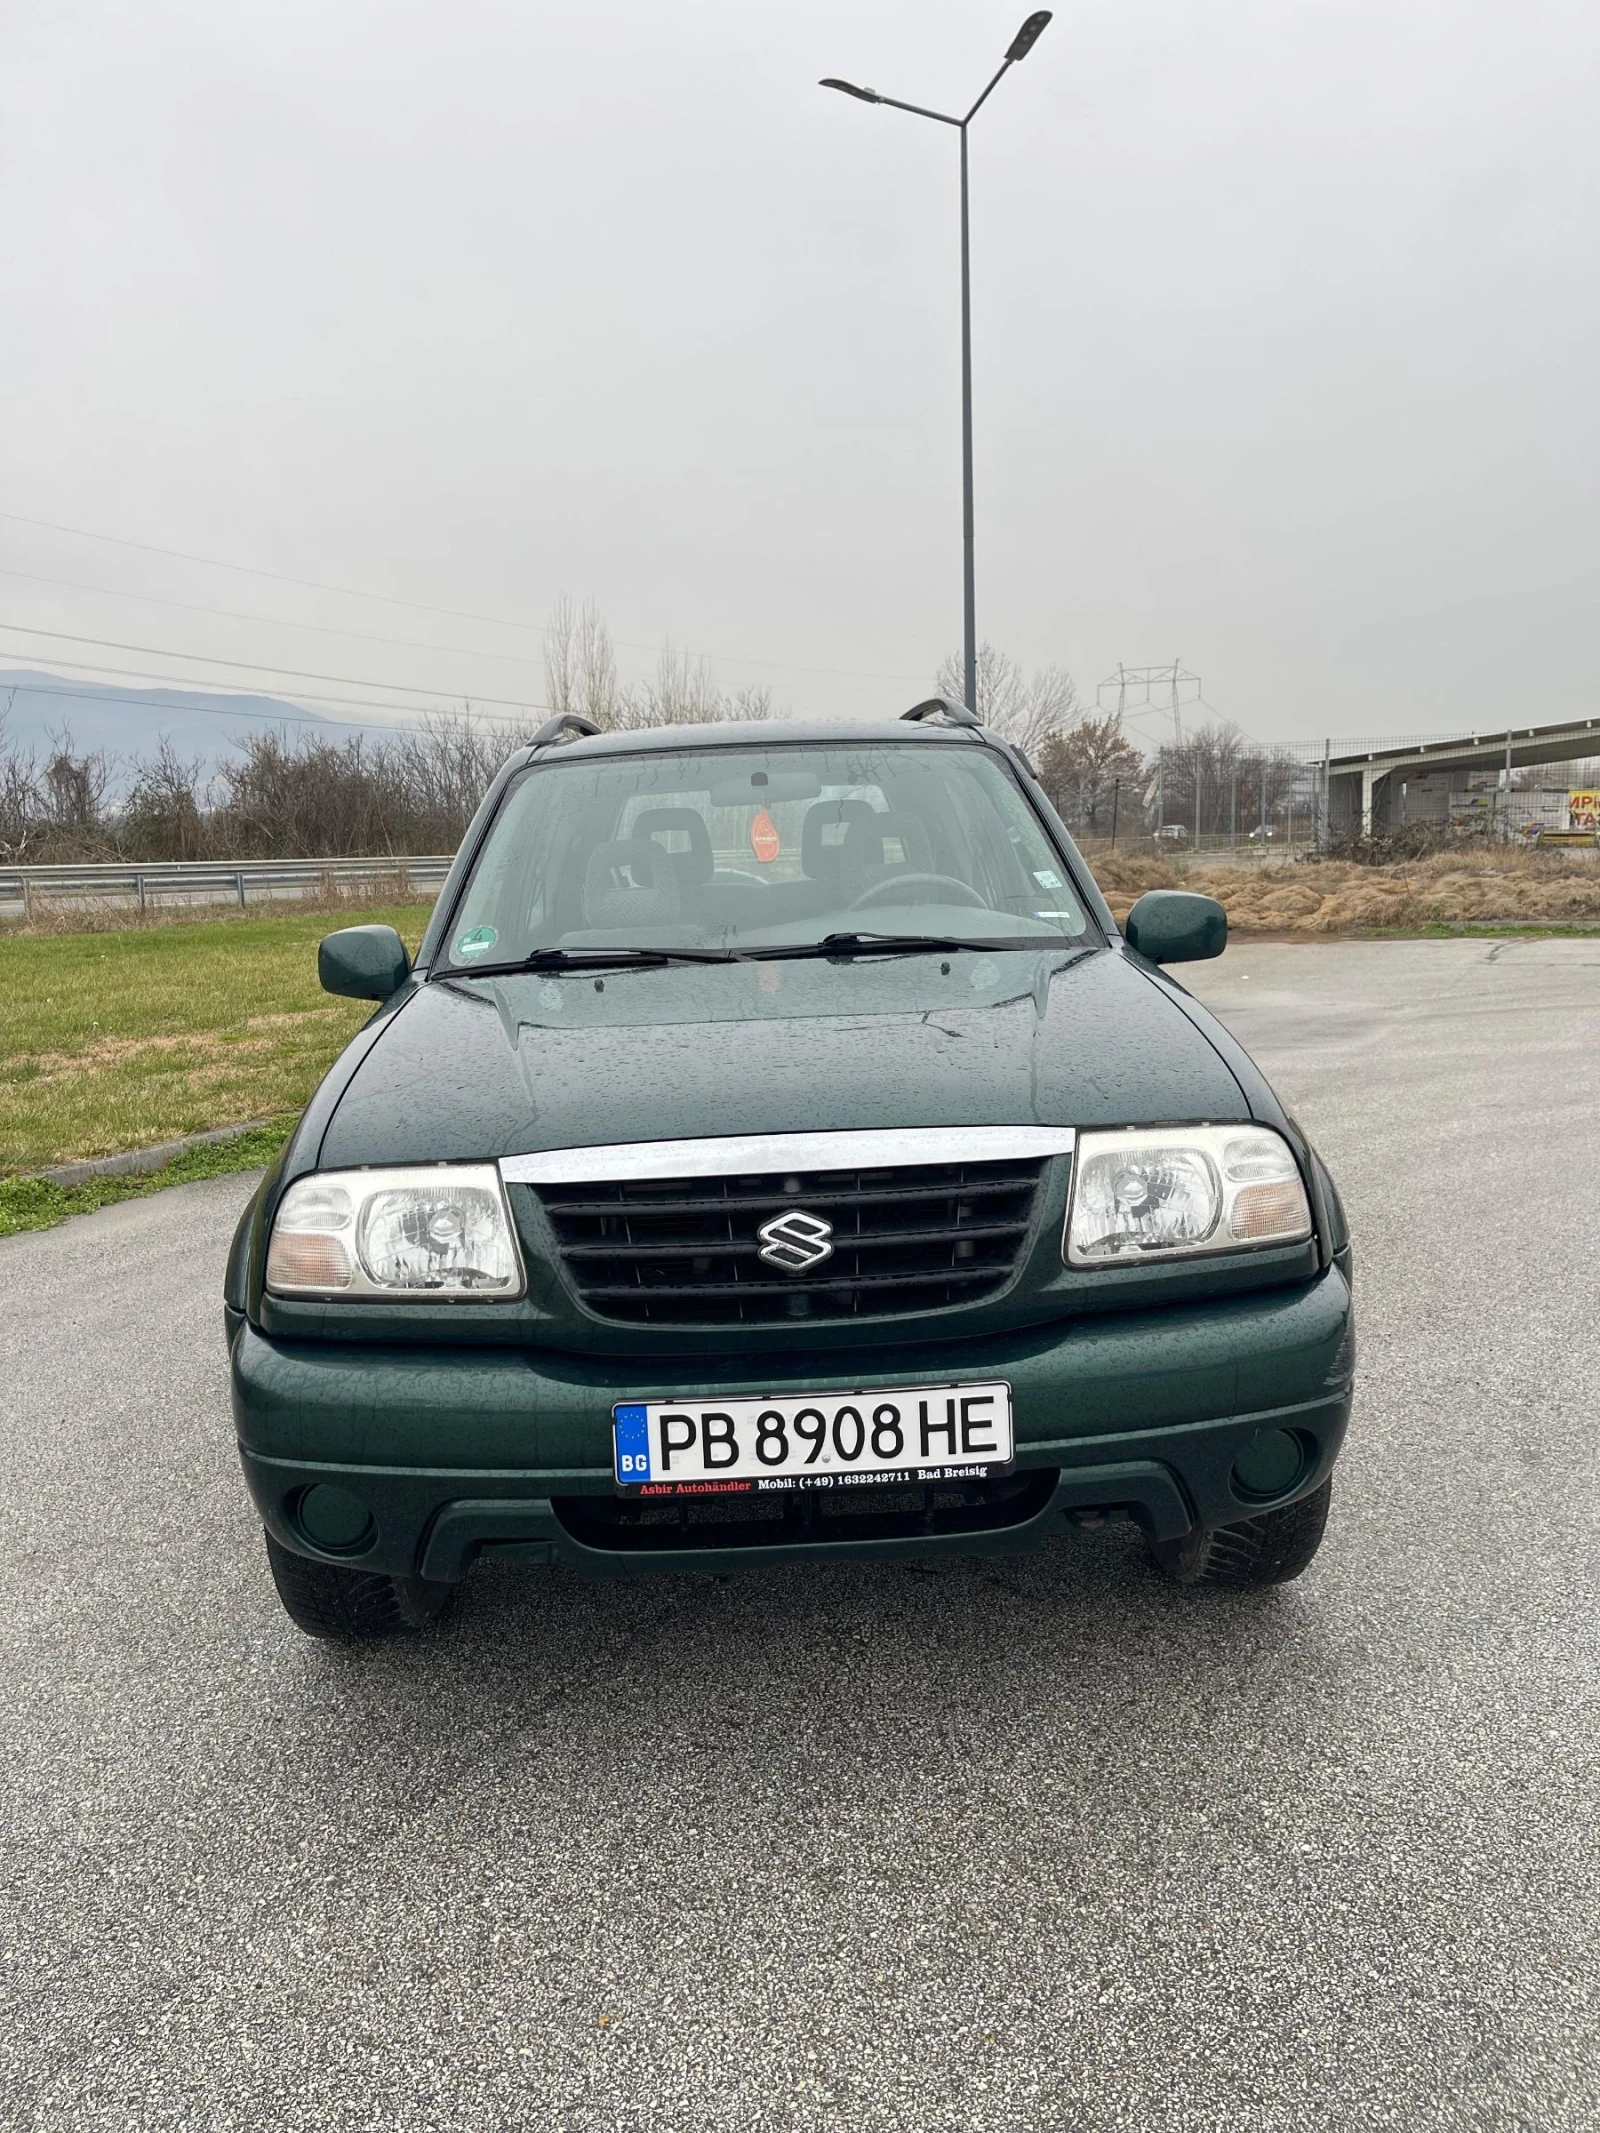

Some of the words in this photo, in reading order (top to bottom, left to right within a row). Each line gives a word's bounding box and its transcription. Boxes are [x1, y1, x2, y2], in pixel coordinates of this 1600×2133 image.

[471, 929, 484, 942] 4
[659, 1412, 740, 1471] PB
[756, 1403, 904, 1466] 8908
[919, 1395, 997, 1457] HE
[621, 1454, 648, 1472] BG
[640, 1484, 673, 1495] Asbir
[675, 1481, 752, 1494] Autohändler
[758, 1478, 796, 1490] Mobil:
[799, 1476, 834, 1489] (+49)
[837, 1471, 910, 1486] 1632242711
[917, 1468, 942, 1480] Bad
[943, 1465, 988, 1479] Breisig
